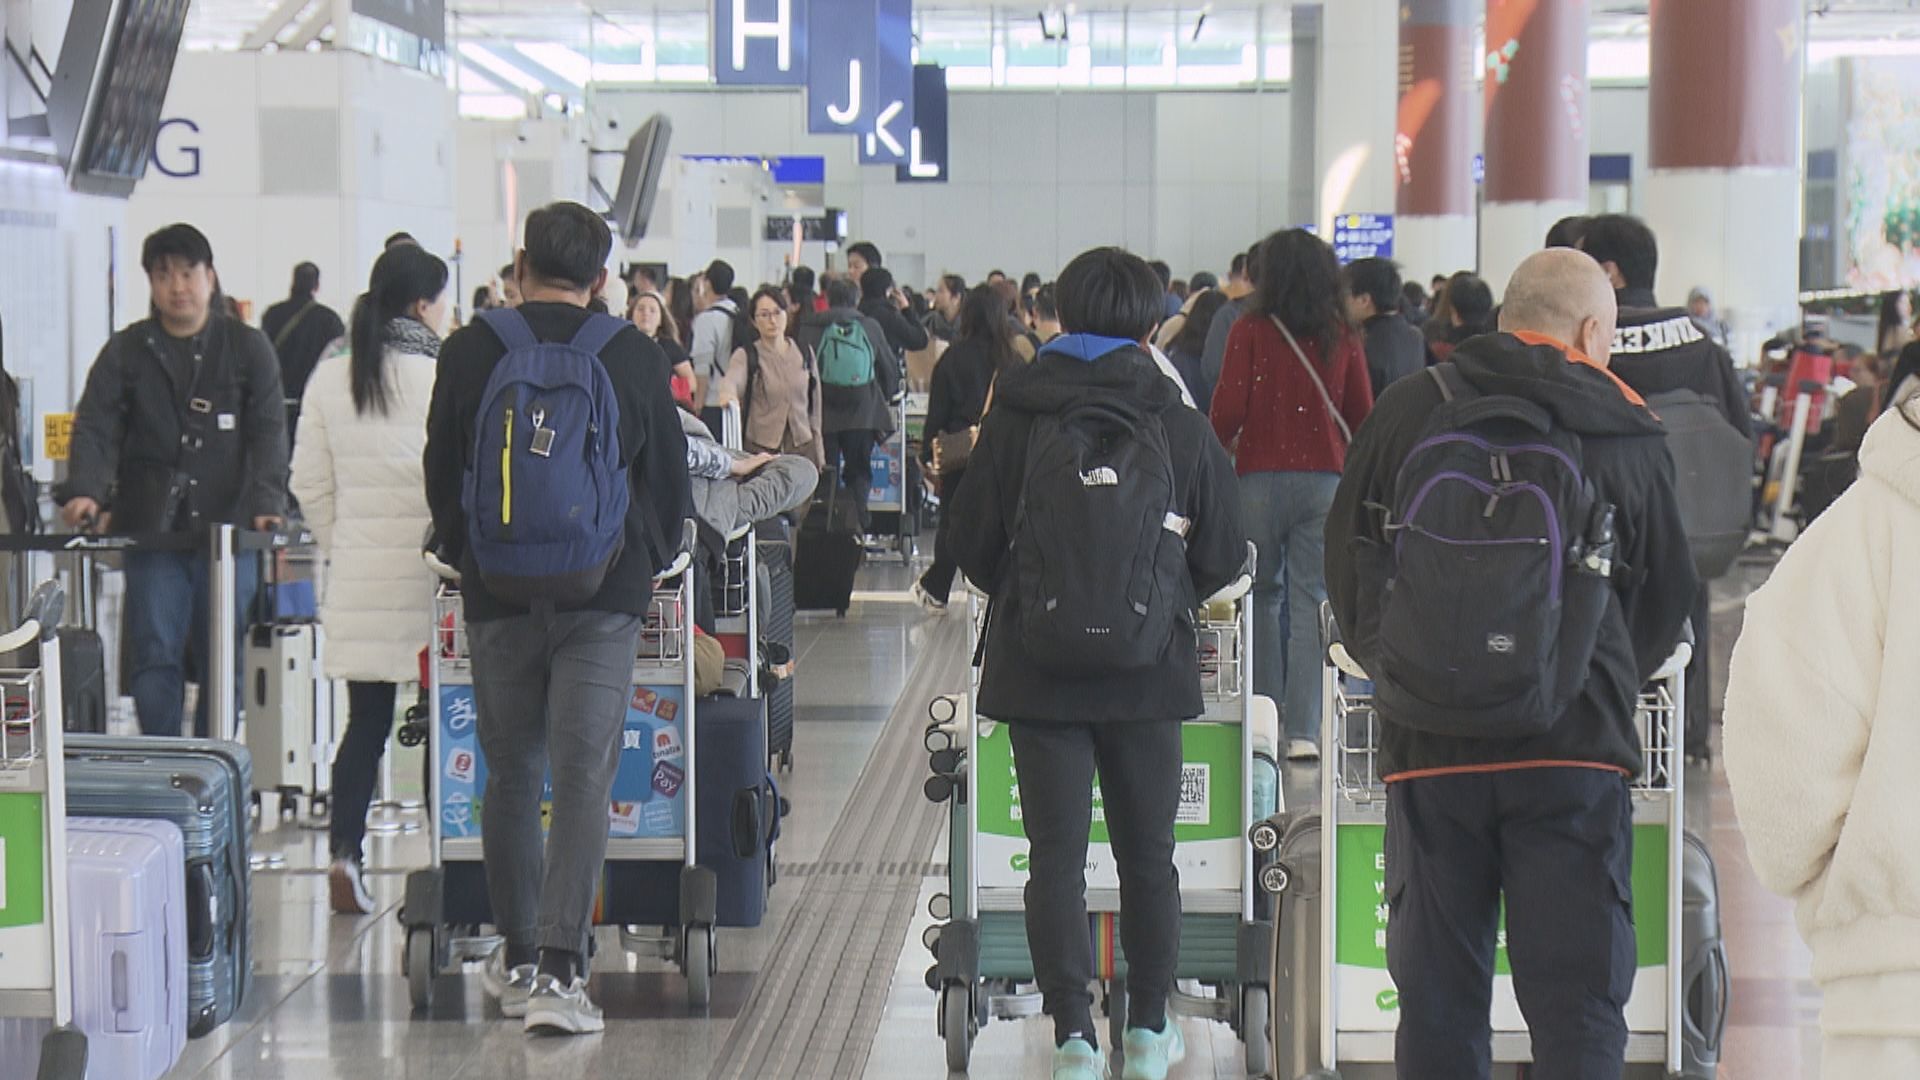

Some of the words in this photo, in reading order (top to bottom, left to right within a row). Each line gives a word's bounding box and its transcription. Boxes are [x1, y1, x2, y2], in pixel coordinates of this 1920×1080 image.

[732, 0, 791, 71] H
[826, 58, 861, 124] J
[152, 118, 199, 178] G
[866, 100, 905, 157] K
[909, 127, 939, 177] L
[48, 440, 67, 456] Ou
[653, 769, 677, 793] Pay
